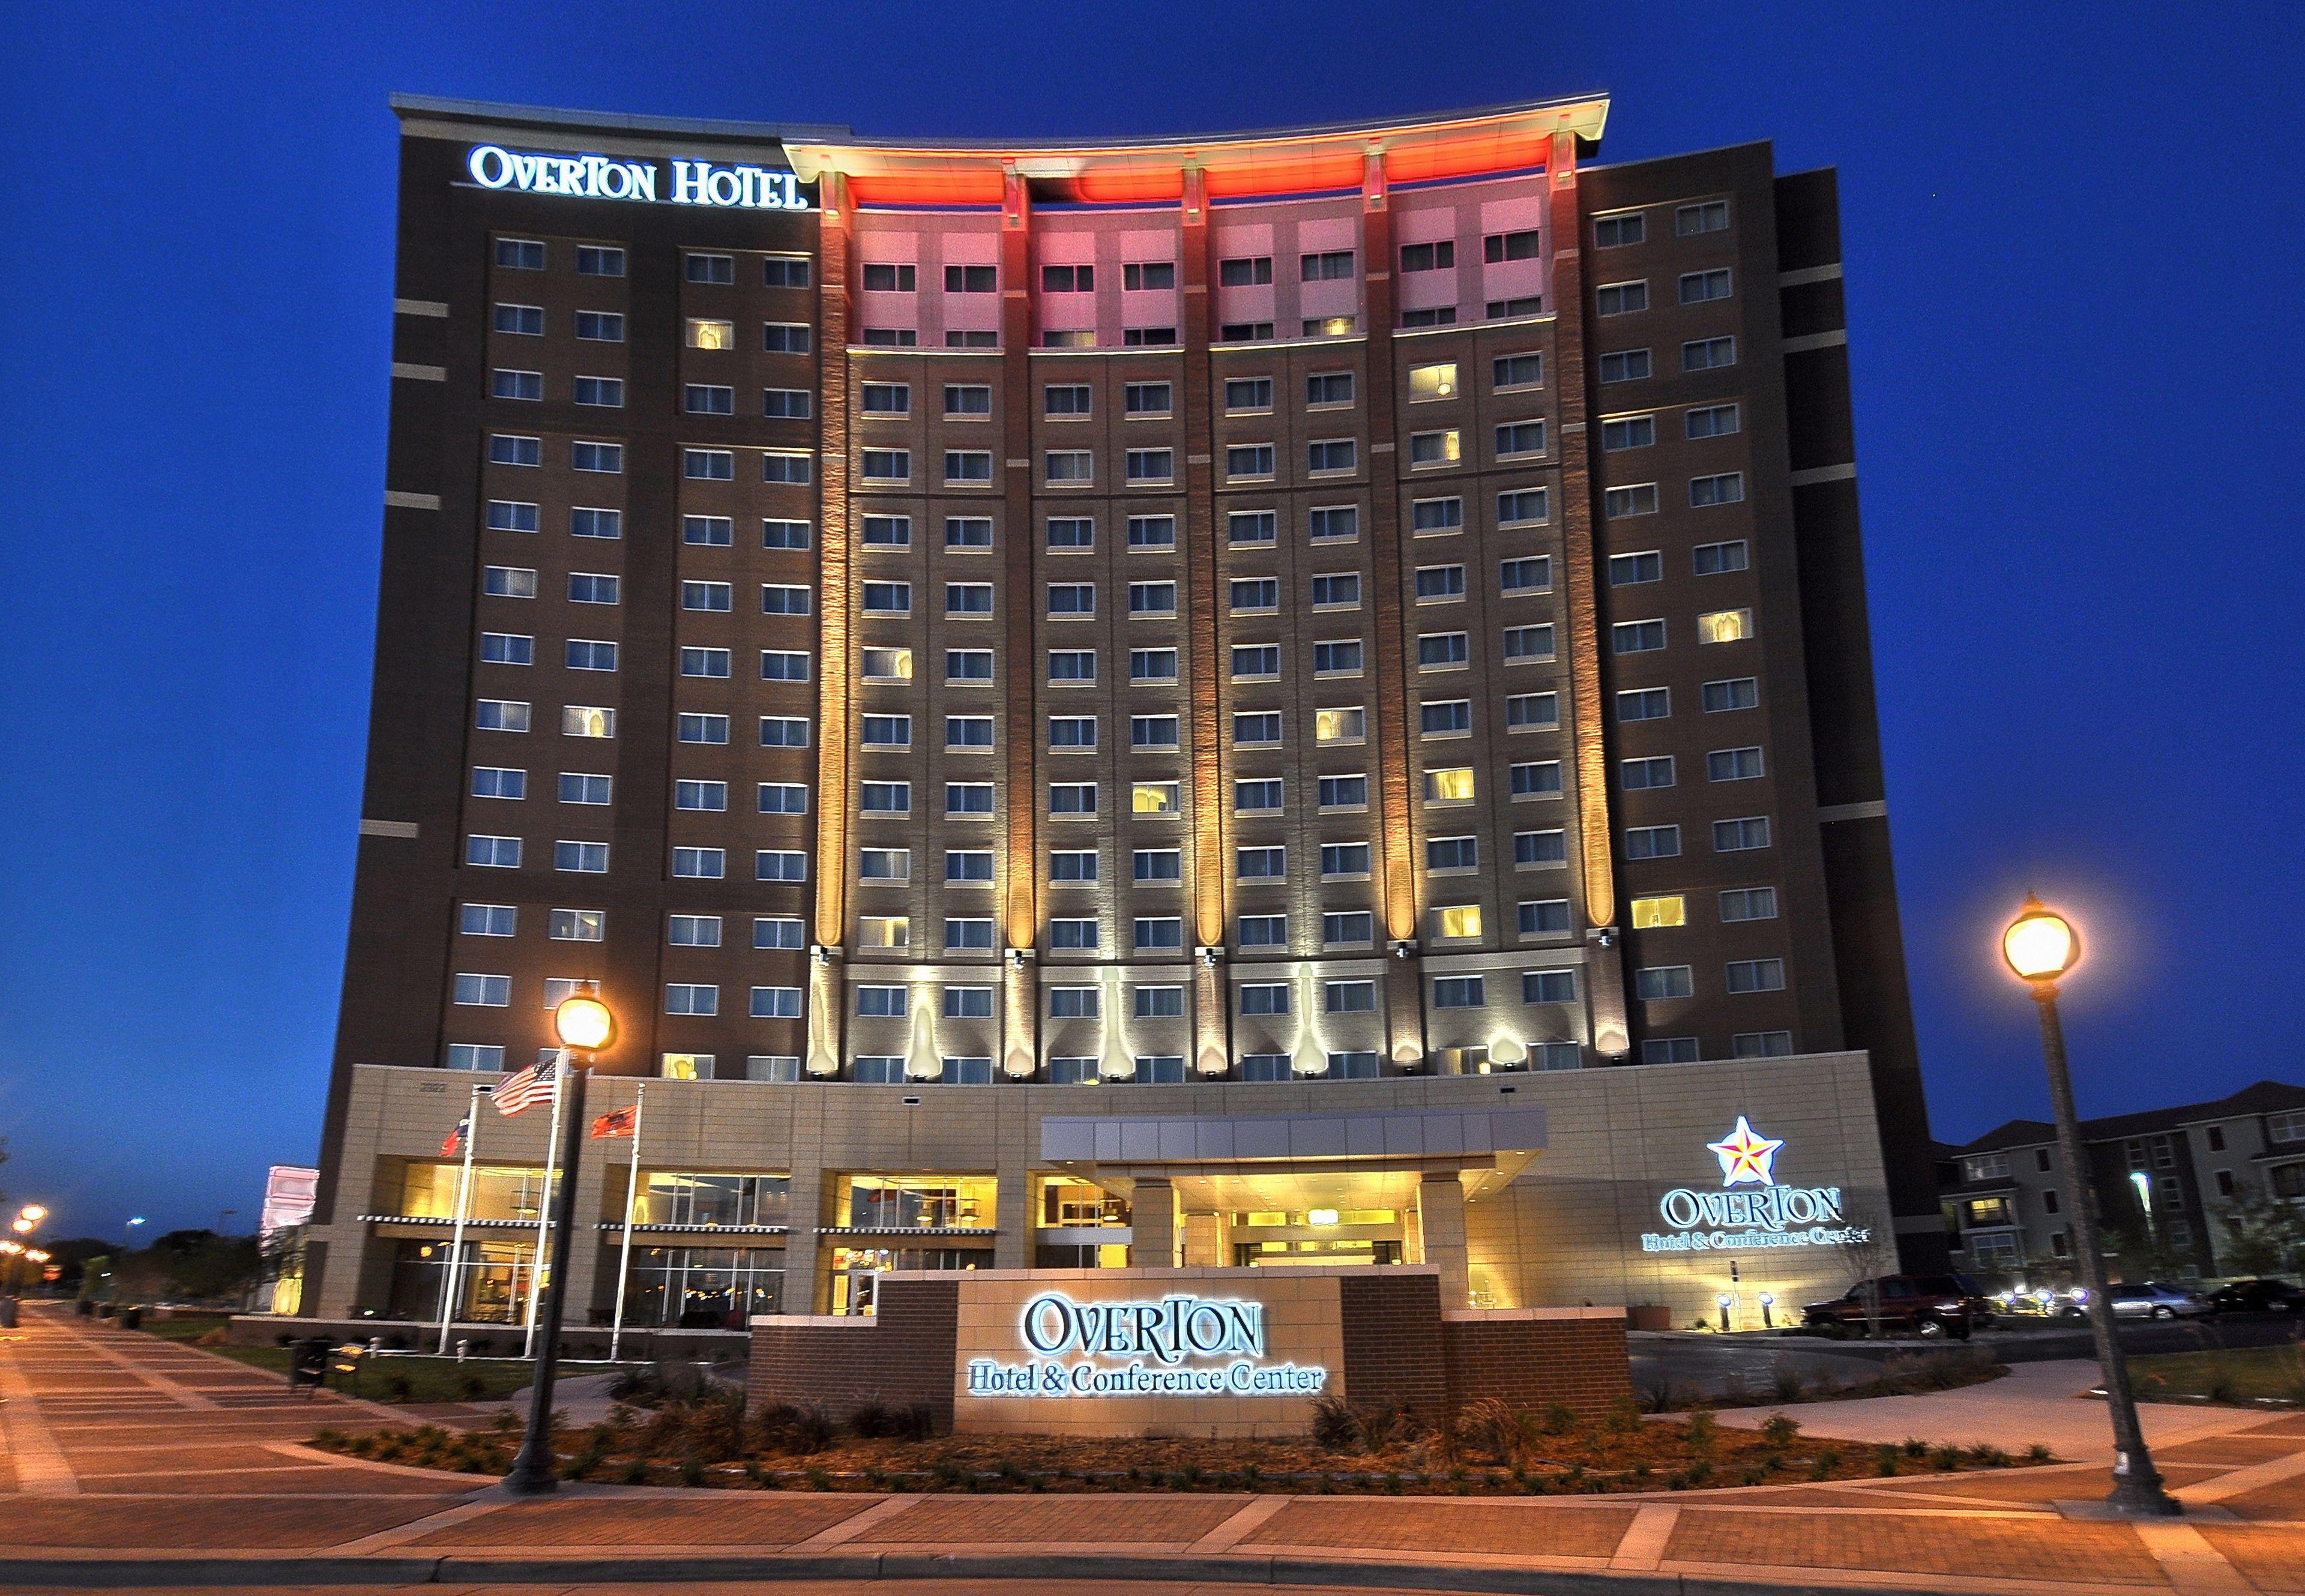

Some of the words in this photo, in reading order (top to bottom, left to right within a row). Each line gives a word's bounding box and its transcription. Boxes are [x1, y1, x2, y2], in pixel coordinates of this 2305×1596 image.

[469, 146, 658, 203] OVERTON
[672, 160, 808, 209] HOTEL
[1660, 1185, 1844, 1232] OVERTON
[1642, 1232, 1690, 1251] Hotel
[1691, 1232, 1710, 1250] &
[1710, 1228, 1809, 1249] Conference
[1023, 1295, 1262, 1364] OVERTON
[967, 1363, 1036, 1391] Hotel
[1042, 1364, 1065, 1391] &
[1071, 1363, 1223, 1391] Conference
[1231, 1364, 1322, 1391] Center
